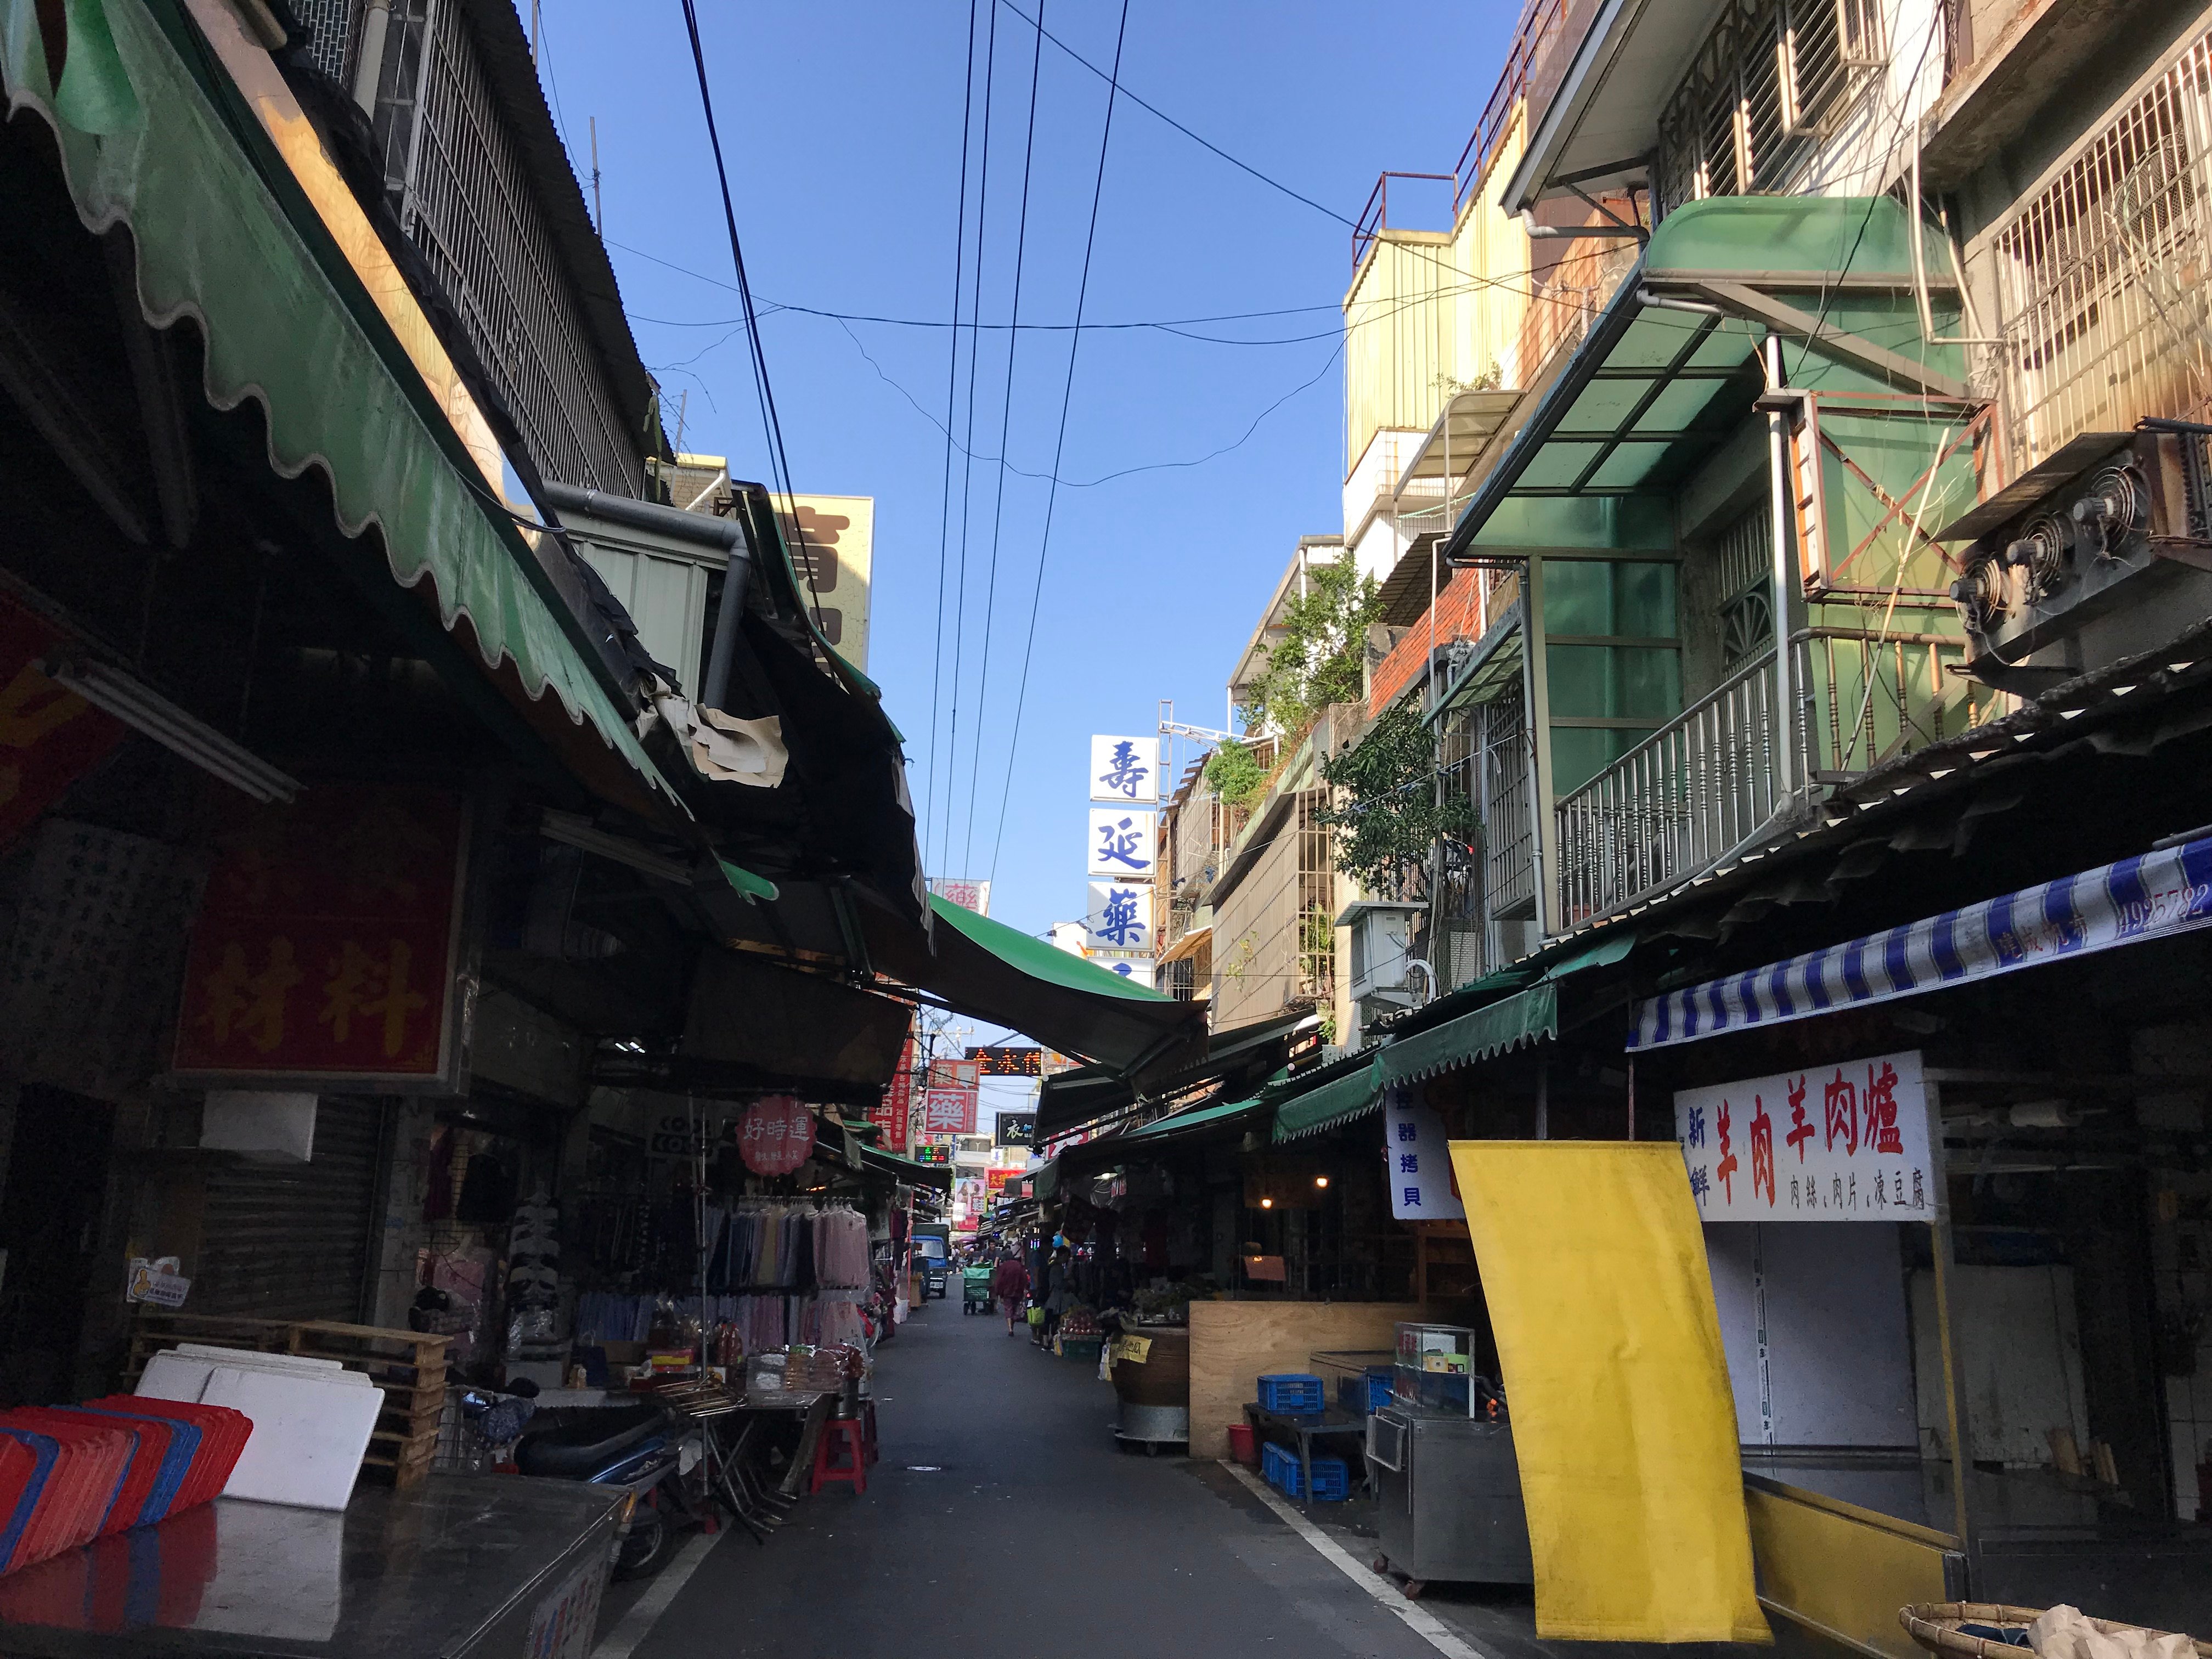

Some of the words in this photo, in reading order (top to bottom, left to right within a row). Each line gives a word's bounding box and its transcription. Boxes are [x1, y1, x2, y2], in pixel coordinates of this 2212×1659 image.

[1096, 741, 1151, 978] 壽延藥
[743, 1115, 809, 1142] 好時運
[928, 1093, 964, 1129] 藥
[1689, 1107, 1710, 1206] 新鮮
